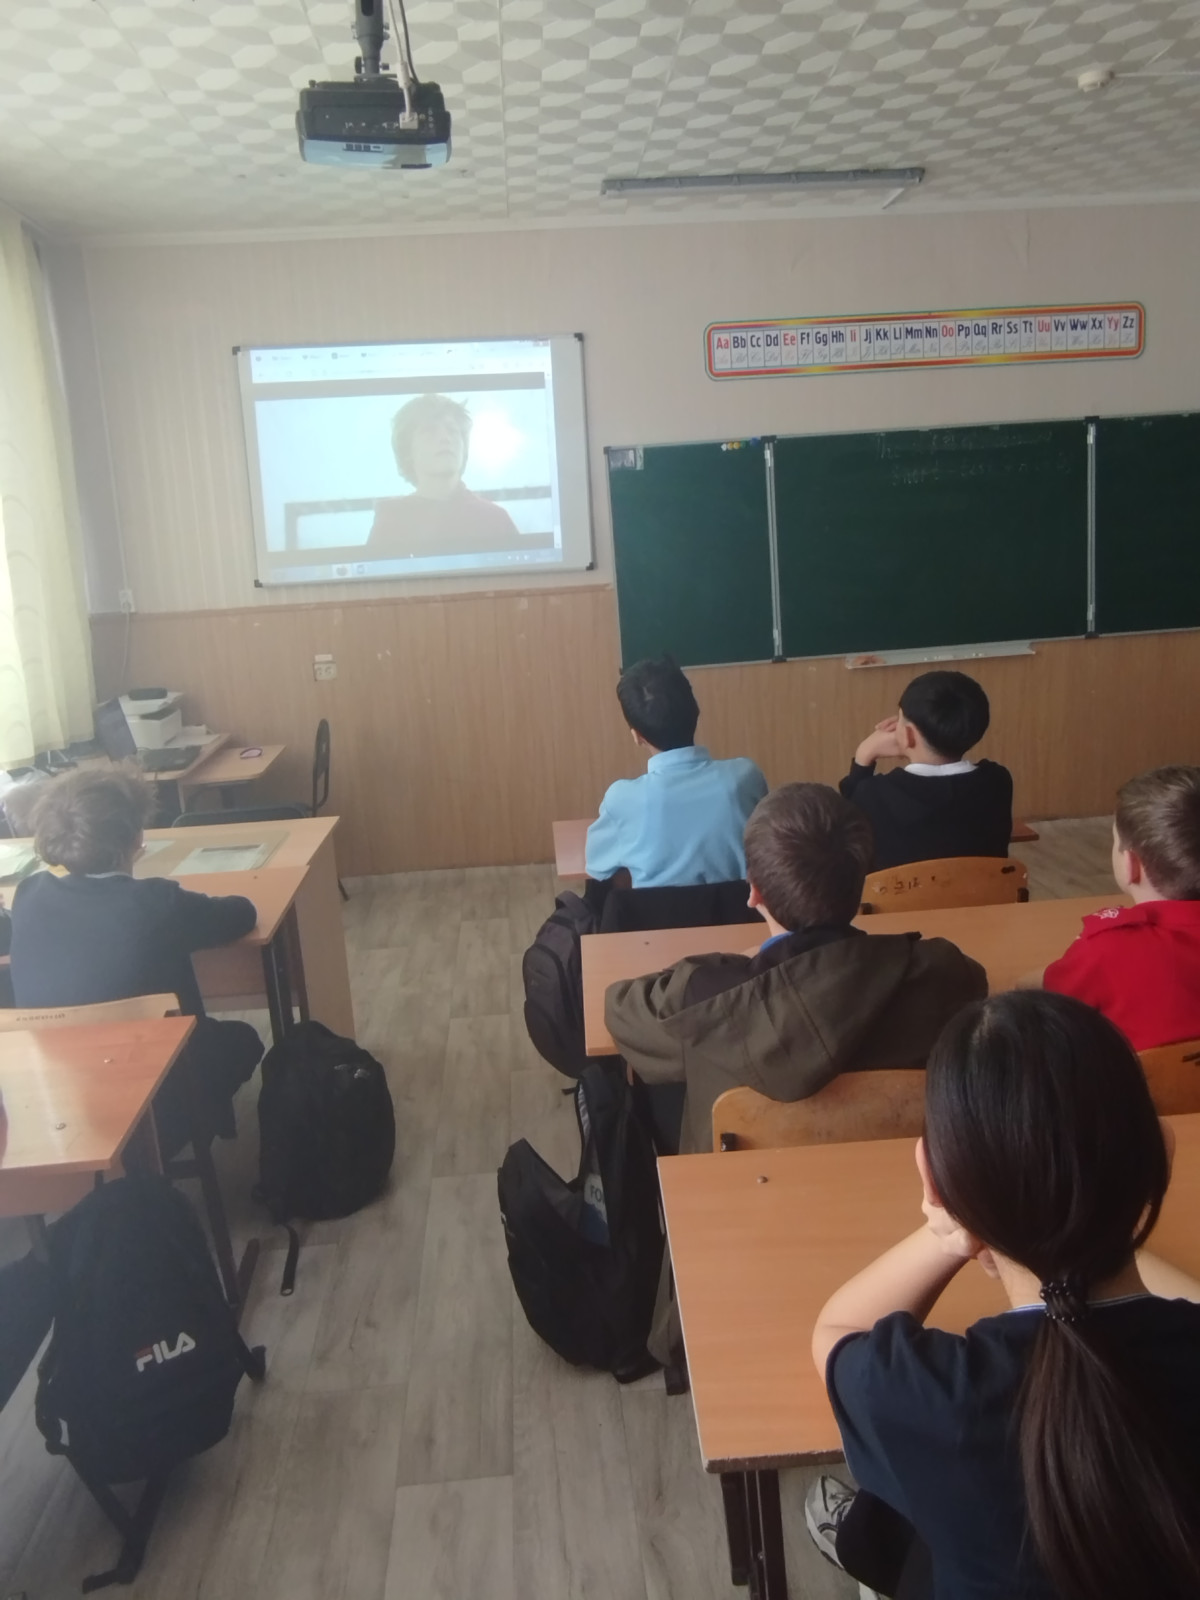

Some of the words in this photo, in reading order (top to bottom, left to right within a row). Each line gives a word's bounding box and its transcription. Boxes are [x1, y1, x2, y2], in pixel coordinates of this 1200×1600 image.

[717, 337, 729, 349] Aa
[733, 336, 746, 348] Bb
[751, 335, 761, 347] Cc
[766, 334, 779, 346] Dd
[784, 333, 796, 345] Ee
[801, 333, 810, 344] Ff
[815, 332, 828, 346] Gg
[832, 331, 844, 343] Hh
[864, 330, 872, 344] Jj
[876, 329, 889, 341] Kk
[906, 327, 922, 339] Mm
[925, 326, 937, 338] Nn
[942, 325, 954, 337] Oo
[958, 324, 970, 339] Pp
[974, 324, 986, 338] Qq
[992, 323, 1002, 335] Rr
[1007, 322, 1018, 334] Ss
[1023, 321, 1033, 333] Tt
[1038, 321, 1050, 332] Uu
[1054, 320, 1066, 331] Vv
[1070, 319, 1087, 330] Ww
[1091, 318, 1103, 330] Xx
[1107, 317, 1119, 331] Yy
[1123, 316, 1134, 328] Zz
[590, 1185, 605, 1204] FO
[135, 1332, 196, 1373] FILA
